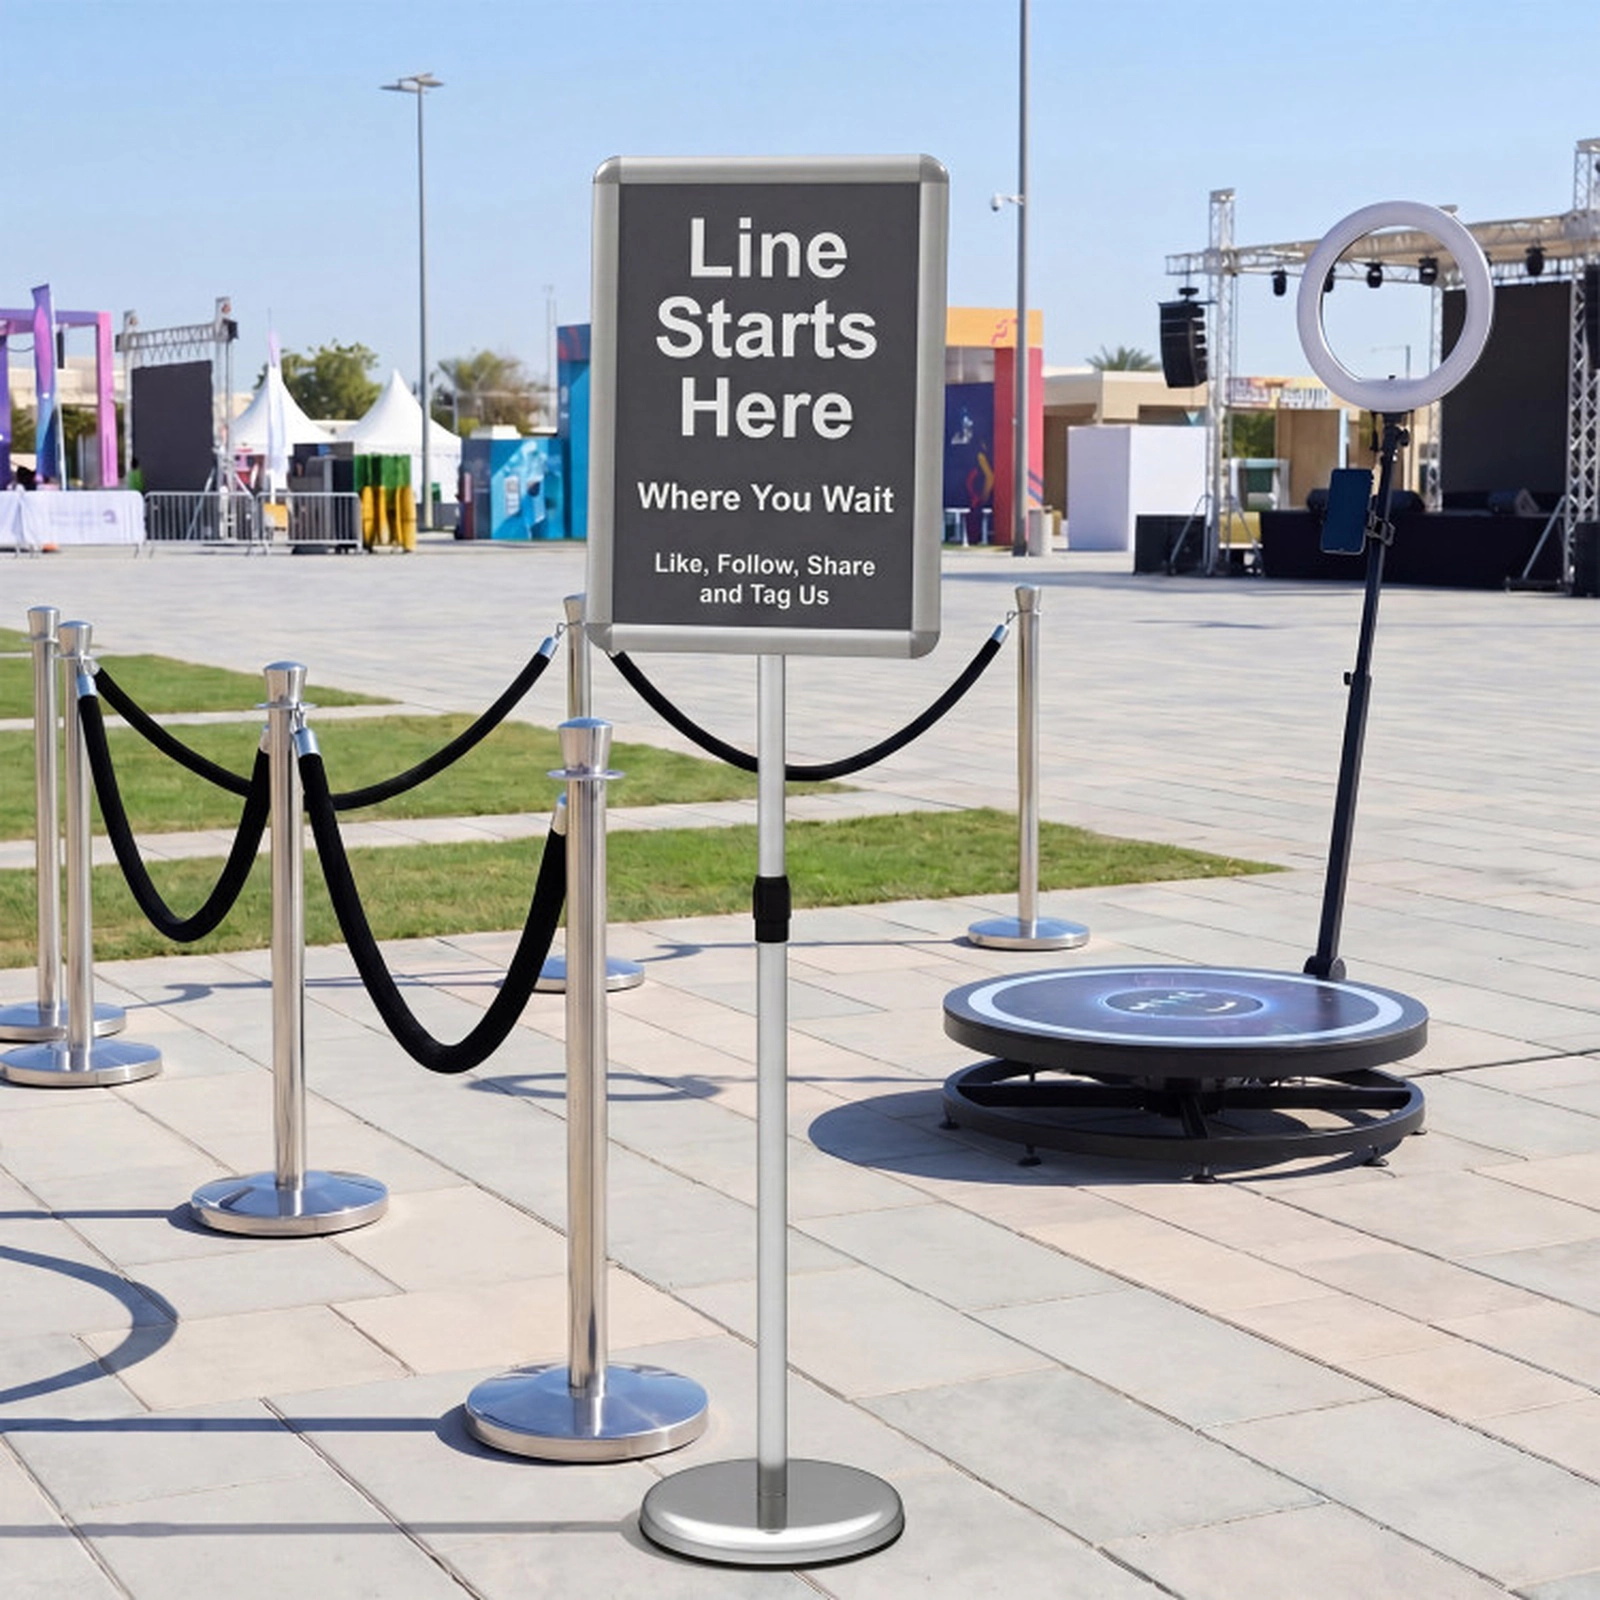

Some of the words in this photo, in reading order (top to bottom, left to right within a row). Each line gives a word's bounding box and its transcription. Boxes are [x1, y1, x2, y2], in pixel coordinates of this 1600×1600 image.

[691, 217, 847, 278] Line
[656, 296, 877, 359] Starts
[682, 377, 852, 439] Here
[638, 482, 740, 510] Where
[751, 484, 811, 512] You
[822, 485, 894, 513] Wait
[656, 553, 708, 576] Like,
[718, 554, 798, 577] Follow,
[808, 555, 875, 576] Share
[700, 584, 742, 603] and
[750, 584, 790, 609] Tag
[800, 585, 829, 605] Us
